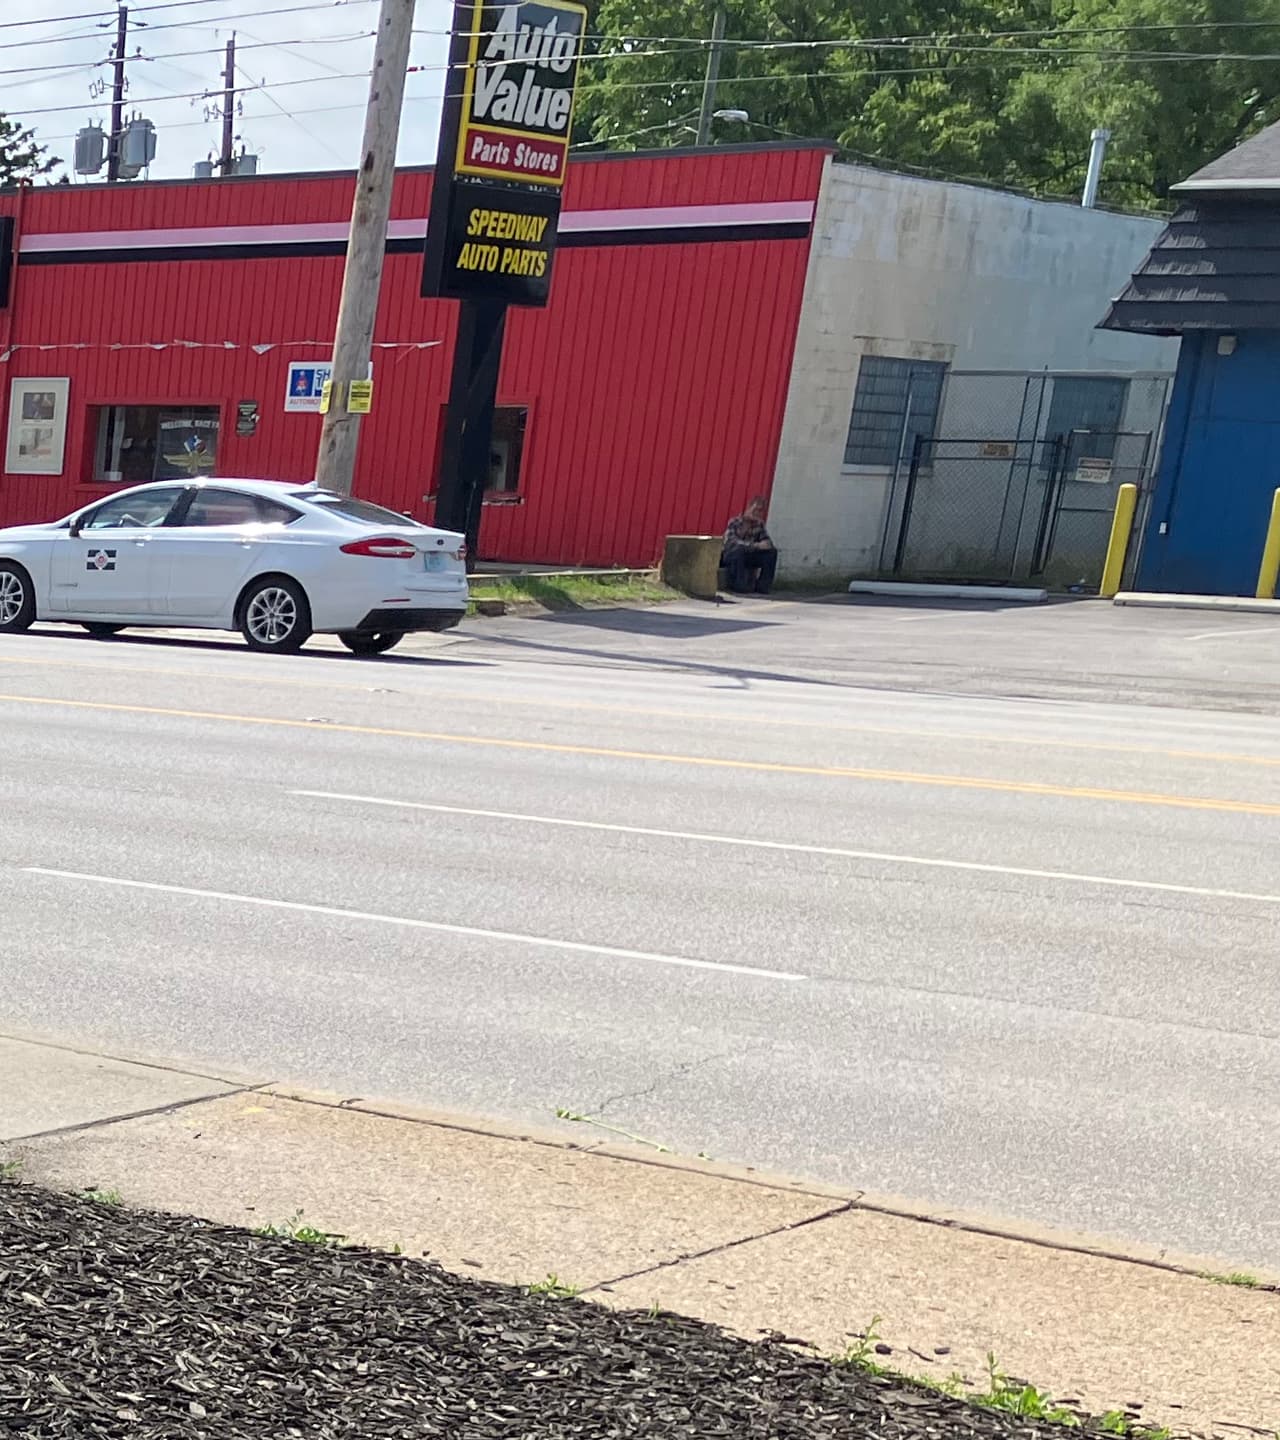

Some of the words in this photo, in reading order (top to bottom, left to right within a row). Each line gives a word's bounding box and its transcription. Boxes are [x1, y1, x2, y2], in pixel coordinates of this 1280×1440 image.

[485, 5, 576, 74] Auto
[473, 62, 572, 131] Value
[470, 136, 511, 165] Parts
[513, 143, 559, 173] Stores
[467, 208, 548, 242] SPEEDWAY
[456, 243, 499, 272] AUTO
[500, 247, 548, 277] PARTS
